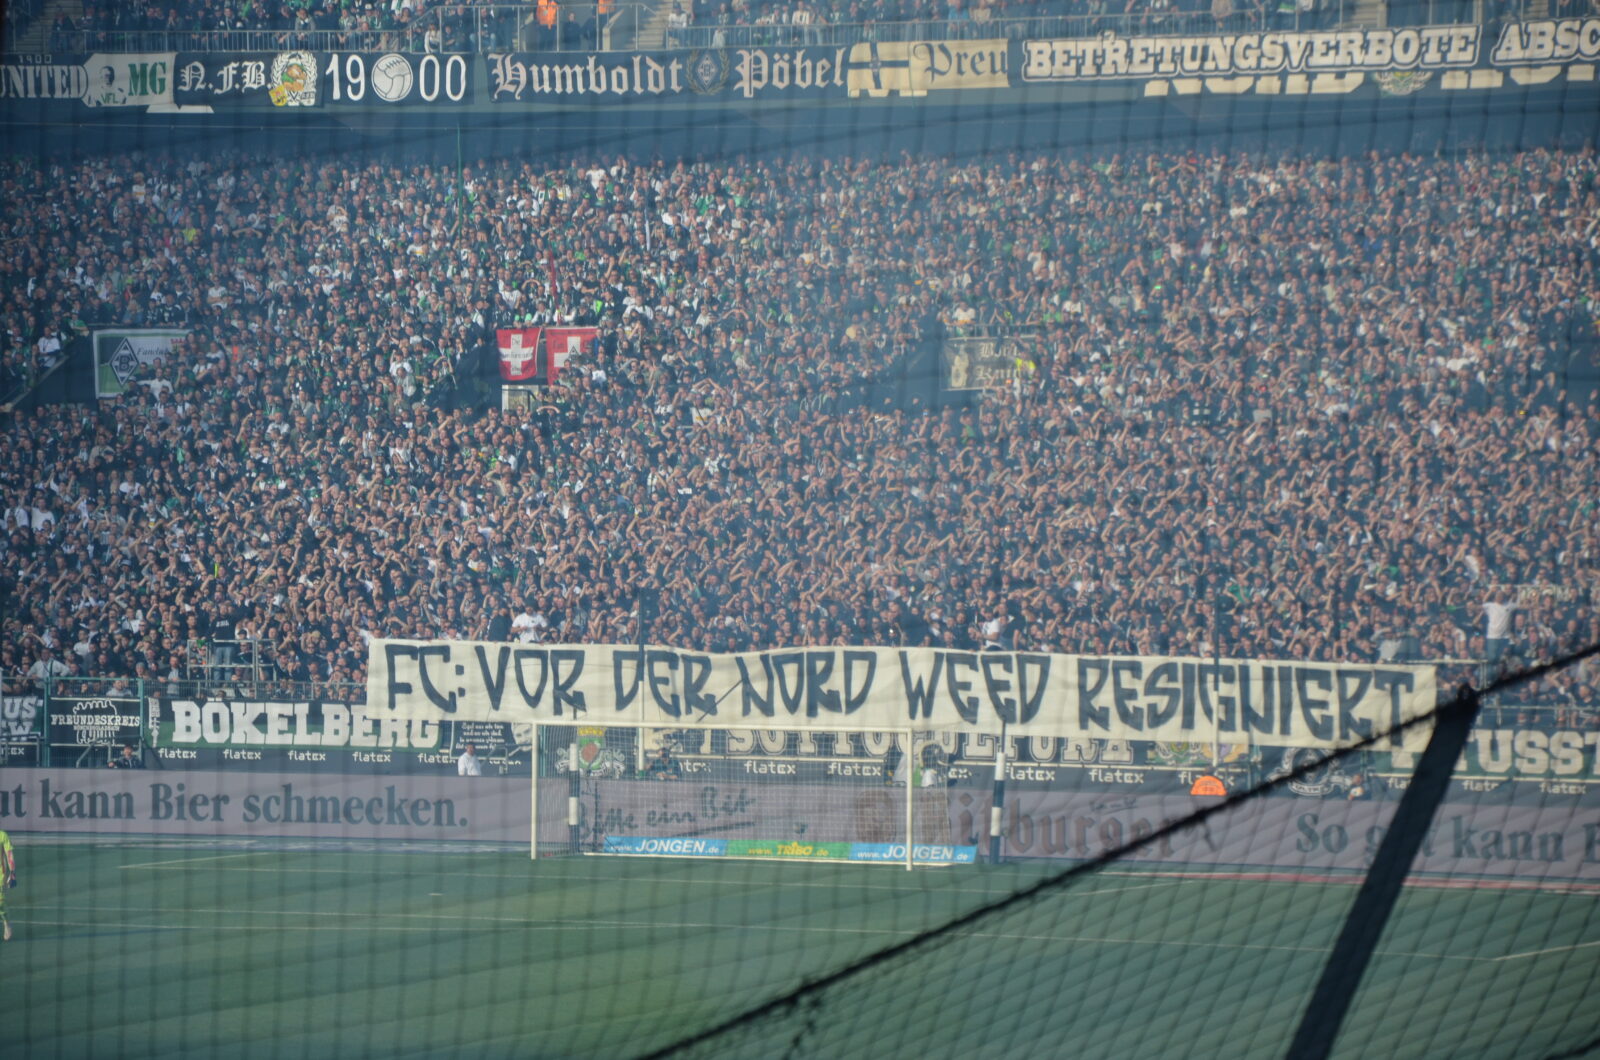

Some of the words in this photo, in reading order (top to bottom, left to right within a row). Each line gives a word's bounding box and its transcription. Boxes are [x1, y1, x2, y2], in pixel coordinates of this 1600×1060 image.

[1025, 26, 1477, 79] BETRETUNGSVERBOTE
[128, 62, 167, 97] MG
[325, 54, 365, 101] 19
[488, 53, 683, 100] Humboldt
[734, 48, 846, 98] Pöbel
[612, 649, 718, 718] DER
[735, 651, 877, 718] NORD
[899, 651, 1051, 725] WEED
[51, 714, 140, 727] FREUNDESKREIS
[171, 697, 439, 749] BÖKELBERG
[157, 748, 197, 760] flatex
[222, 749, 262, 761] flatex
[287, 750, 326, 762] flatex
[352, 751, 391, 763] flatex
[744, 761, 797, 775] flatex
[828, 761, 882, 777] flatex
[1088, 768, 1145, 784] flatex
[39, 777, 136, 820] kann
[148, 782, 230, 822] Bier
[243, 783, 468, 827] schmecken.
[1295, 812, 1349, 854] So
[1450, 815, 1565, 863] kann
[635, 839, 707, 853] JONGEN
